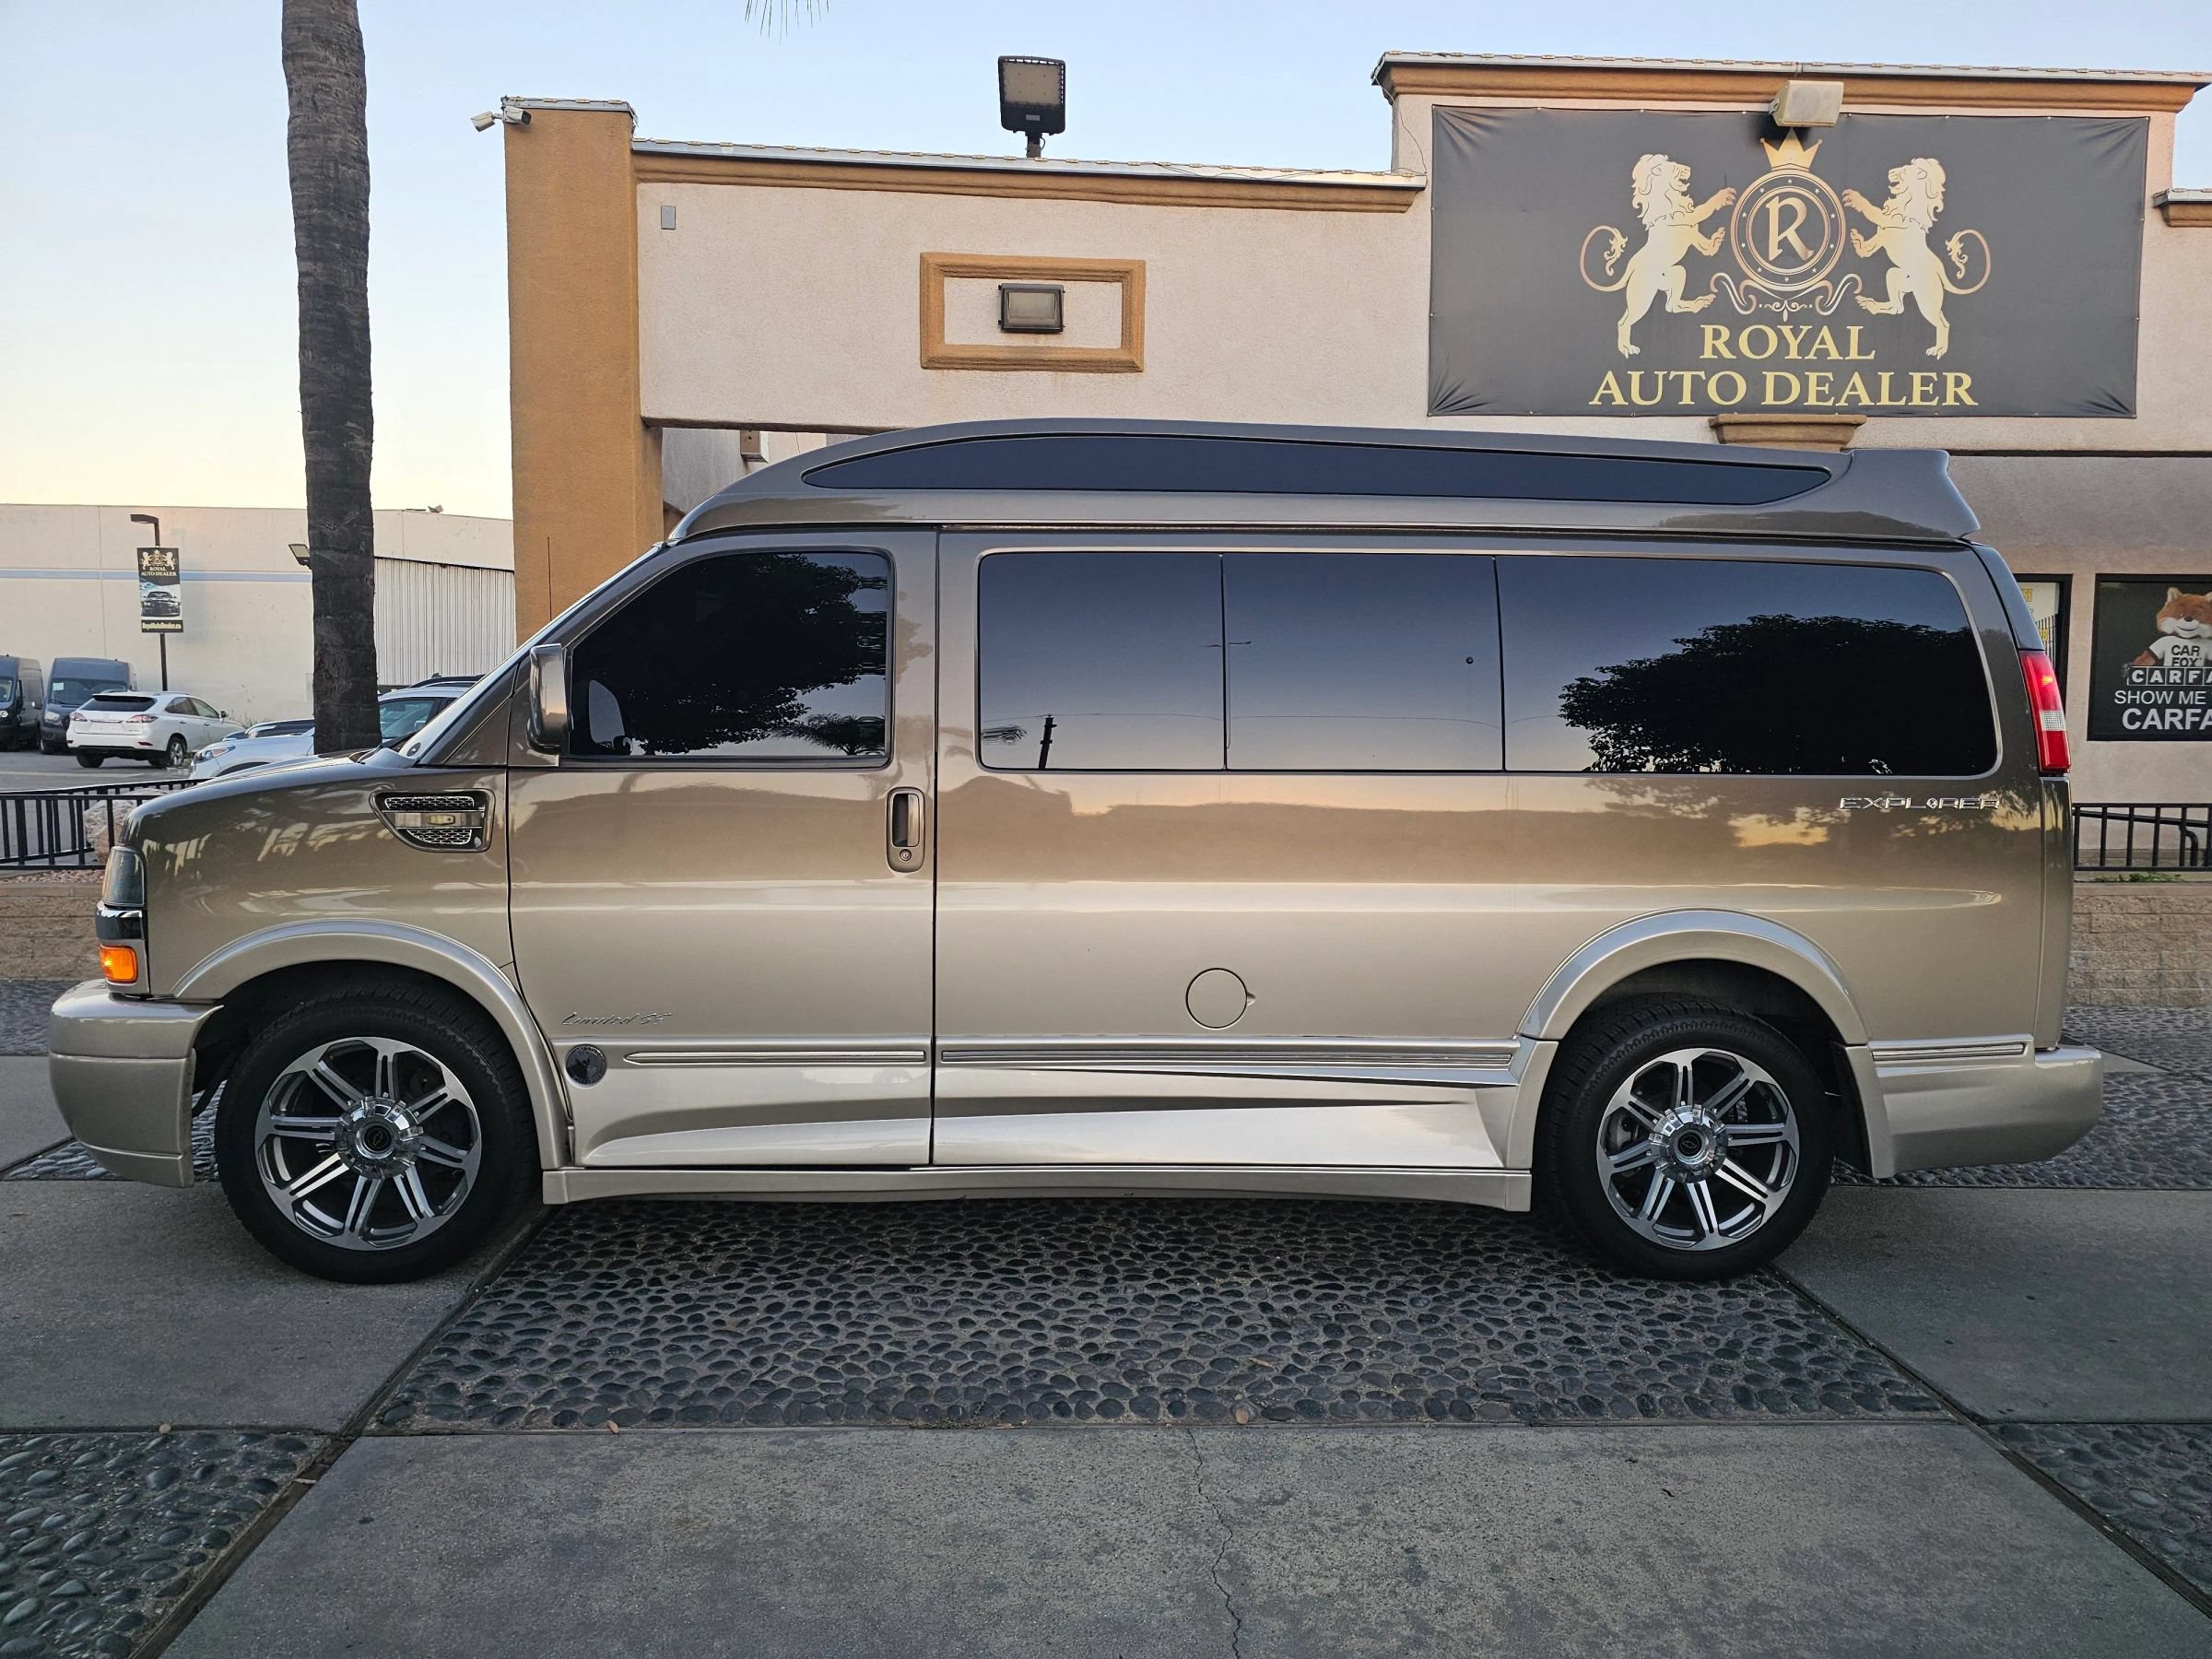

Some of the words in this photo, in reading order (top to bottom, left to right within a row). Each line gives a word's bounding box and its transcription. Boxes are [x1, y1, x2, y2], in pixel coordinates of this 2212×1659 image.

[1765, 195, 1815, 262] R
[1699, 324, 1876, 360] ROYAL
[1588, 370, 1747, 406] AUTO
[1761, 371, 1979, 407] DEALER
[2171, 644, 2200, 656] CAR
[2171, 656, 2198, 667] FOX
[2113, 689, 2174, 705] SHOW
[2178, 690, 2207, 705] ME
[1839, 796, 2000, 810] EXPLORER
